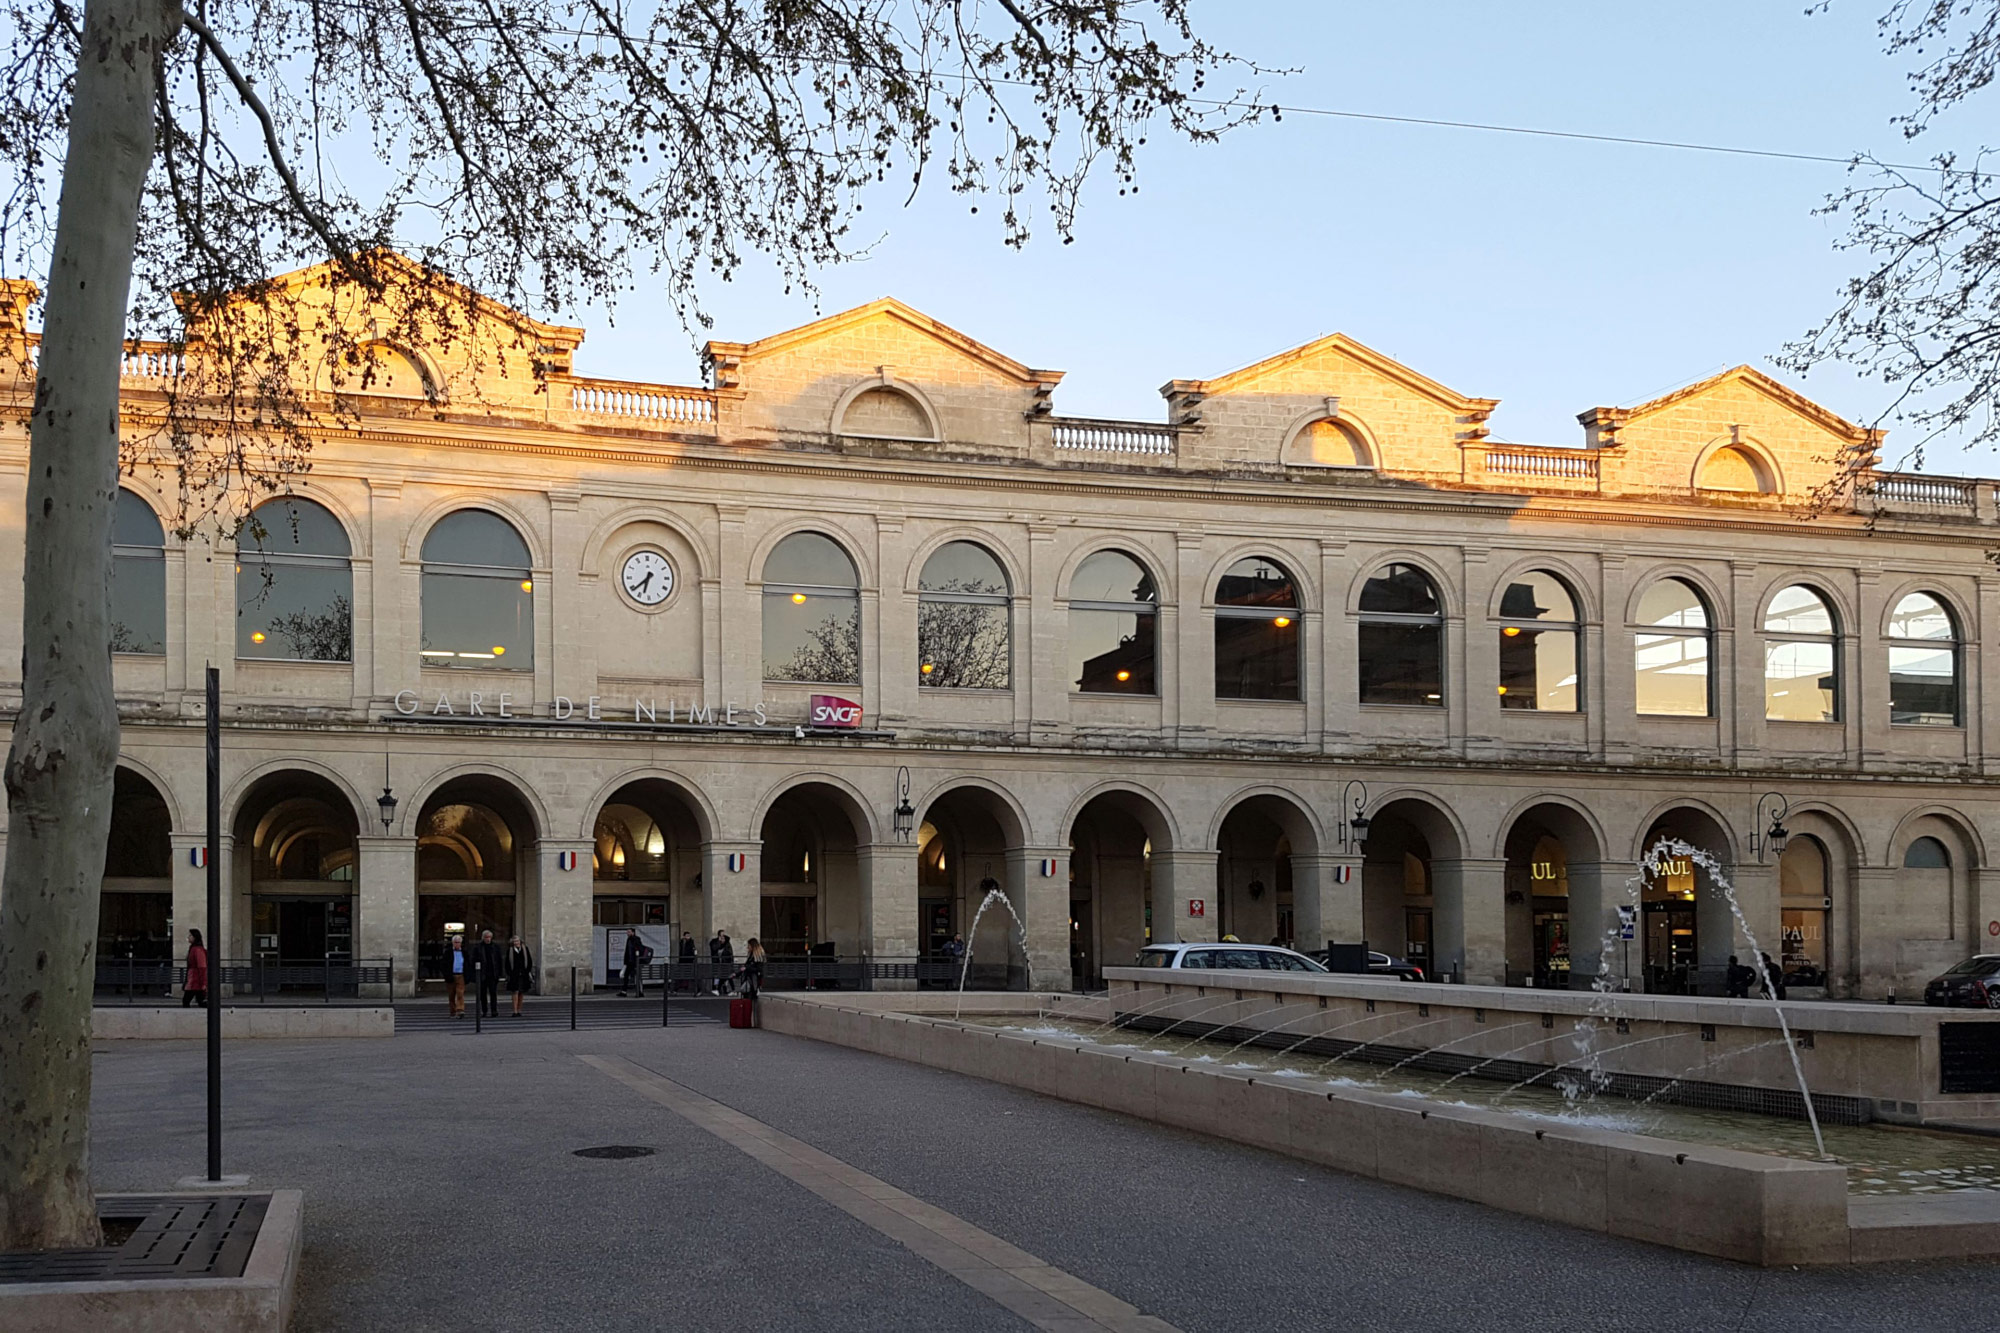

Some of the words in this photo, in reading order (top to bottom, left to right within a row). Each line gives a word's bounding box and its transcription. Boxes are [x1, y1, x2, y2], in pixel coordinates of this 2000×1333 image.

[395, 690, 512, 717] GARE
[555, 696, 601, 720] DE
[635, 698, 766, 726] NIMES
[814, 706, 860, 722] SNCF
[1531, 862, 1556, 879] UL
[1655, 861, 1691, 877] PAUL
[1782, 926, 1822, 941] PAUL
